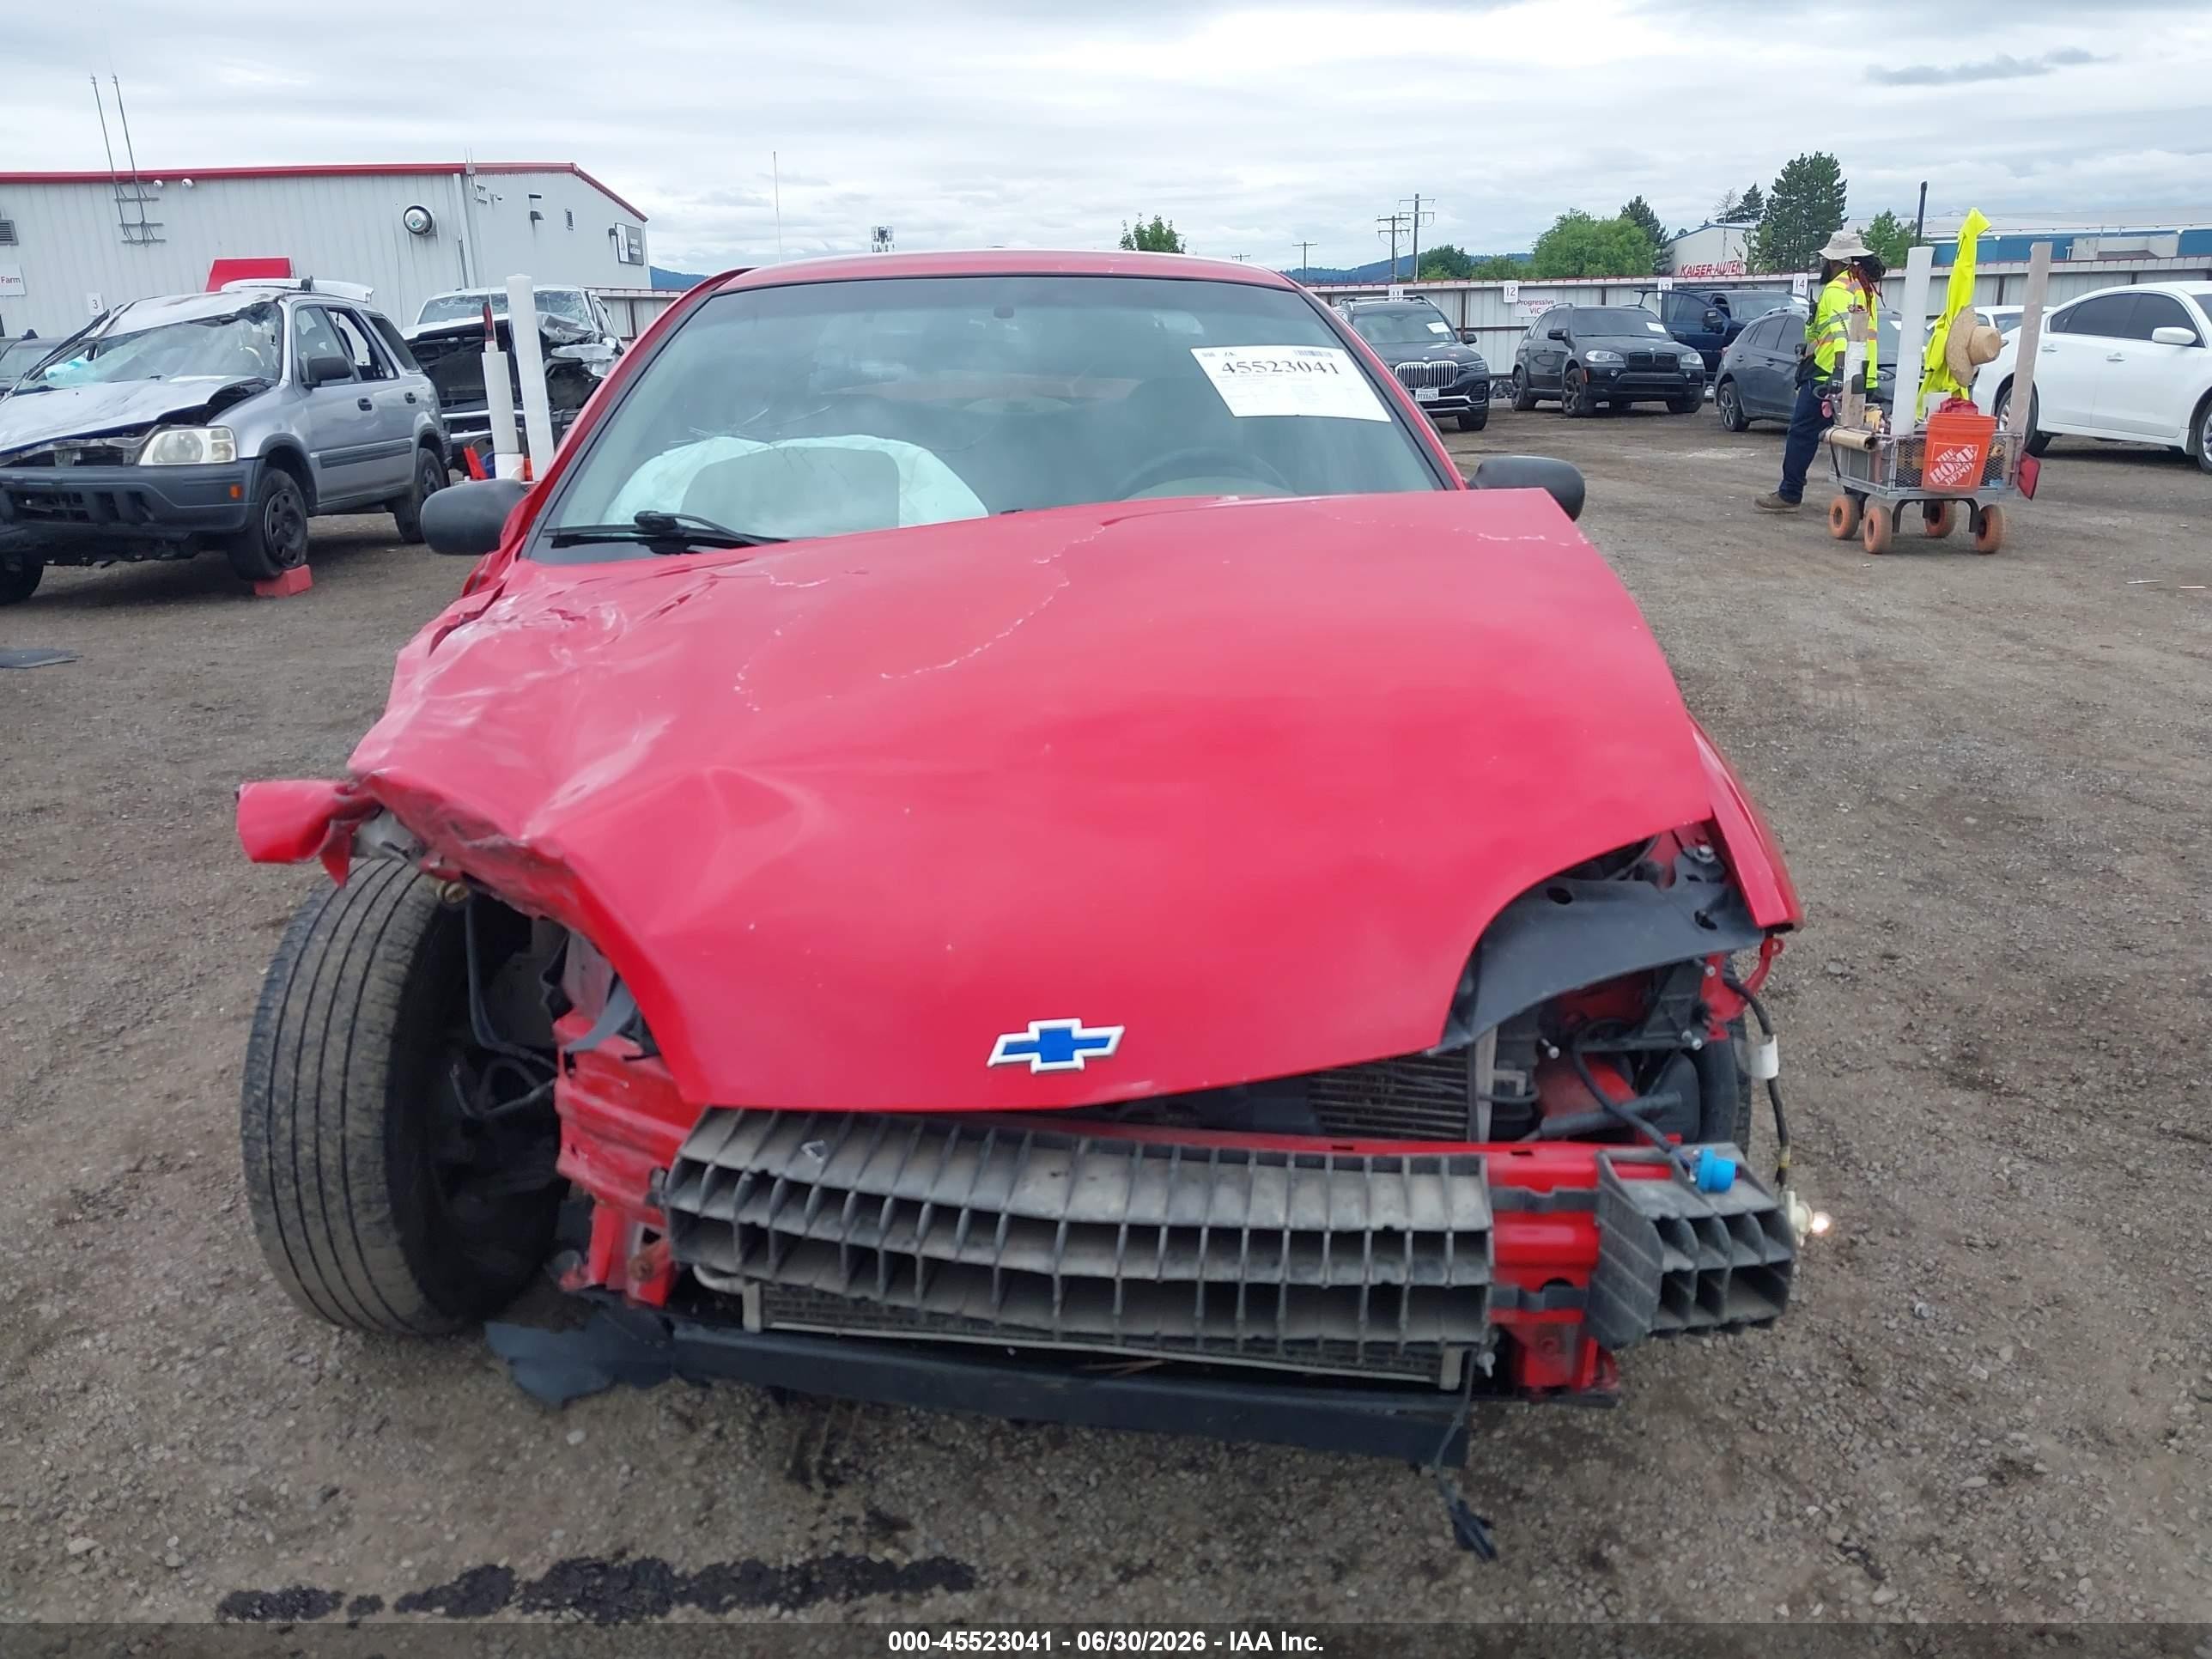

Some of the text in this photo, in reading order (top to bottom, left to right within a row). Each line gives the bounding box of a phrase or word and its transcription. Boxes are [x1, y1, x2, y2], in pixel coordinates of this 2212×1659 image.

[1795, 279, 1806, 289] 14
[1506, 287, 1516, 296] 12
[92, 299, 99, 309] 3
[1222, 360, 1340, 374] 45523041
[1935, 447, 1956, 462] THE
[1929, 446, 1976, 484] HOME
